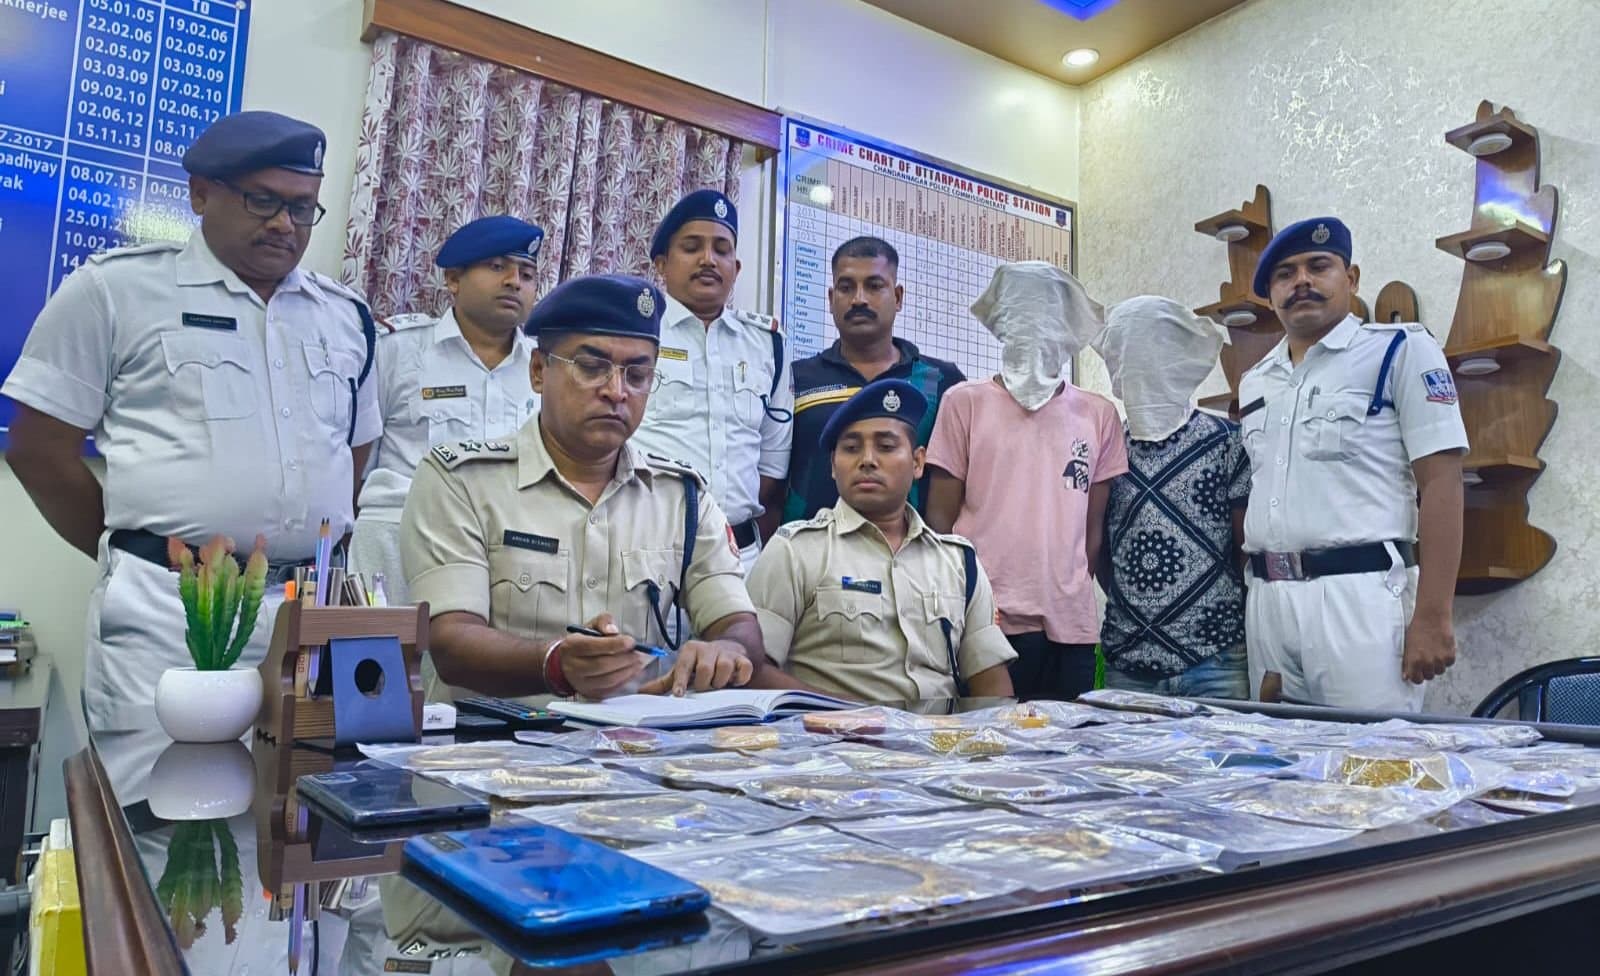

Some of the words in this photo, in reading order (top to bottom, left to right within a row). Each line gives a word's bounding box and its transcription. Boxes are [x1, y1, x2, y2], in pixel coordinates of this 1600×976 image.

[88, 15, 152, 44] 22.02.06
[168, 16, 228, 43] 19.02.06
[85, 36, 150, 64] 02.05.07
[165, 36, 226, 63] 02.05.07
[83, 57, 148, 85] 03.03.09
[163, 57, 224, 83] 03.03.09
[80, 78, 146, 106] 09.02.10
[161, 77, 222, 103] 07.02.10
[78, 100, 144, 127] 02.06.12
[76, 122, 141, 148] 15.11.13
[71, 165, 137, 190] 08.07.15
[817, 134, 854, 156] CRIME
[859, 147, 894, 168] CHART
[898, 160, 911, 173] OF
[915, 165, 973, 193] UTTARPARA
[977, 185, 1010, 205] POLICE
[1013, 196, 1051, 217] STATION
[929, 181, 951, 193] POLICE
[68, 187, 135, 210] 04.02.19
